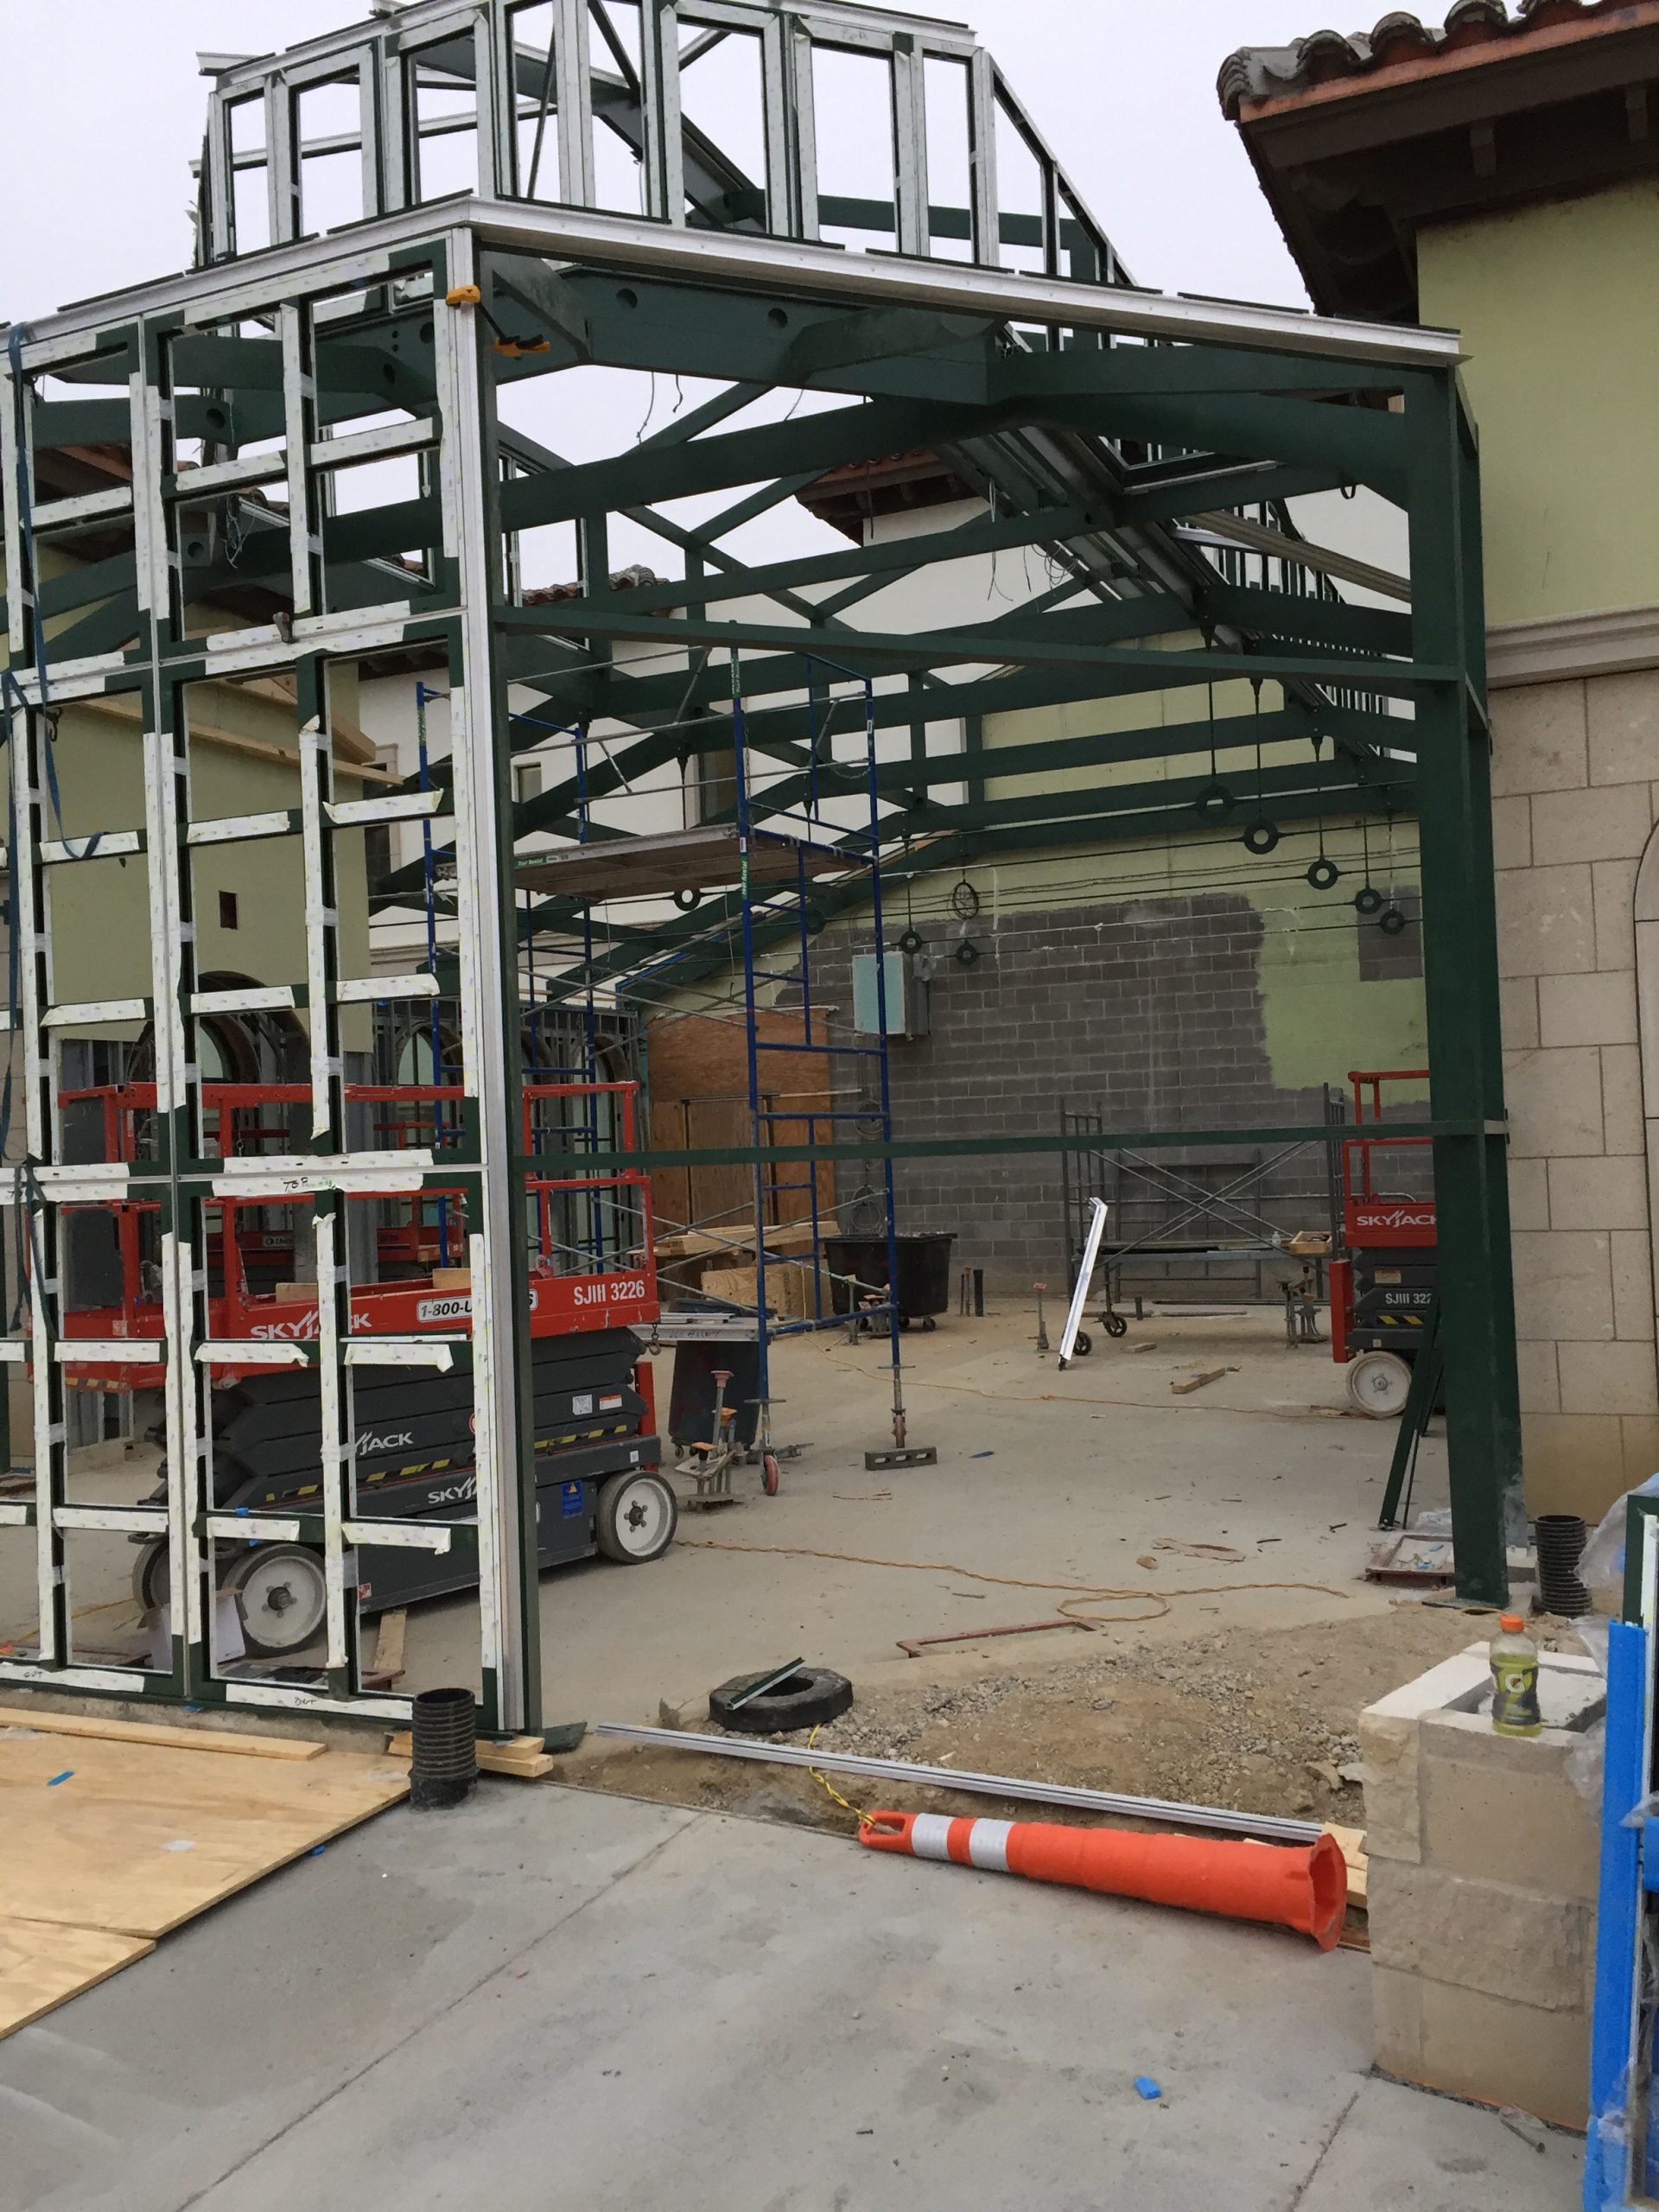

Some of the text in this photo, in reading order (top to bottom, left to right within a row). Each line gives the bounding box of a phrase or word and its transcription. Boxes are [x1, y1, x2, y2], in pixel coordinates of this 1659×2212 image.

[283, 1177, 308, 1192] TOP
[610, 1280, 645, 1301] 3226
[1385, 1293, 1432, 1304] SJIII 322
[421, 1300, 473, 1318] 1-800-U
[251, 1310, 372, 1340] SKYJK
[428, 1476, 477, 1504] SKYJ
